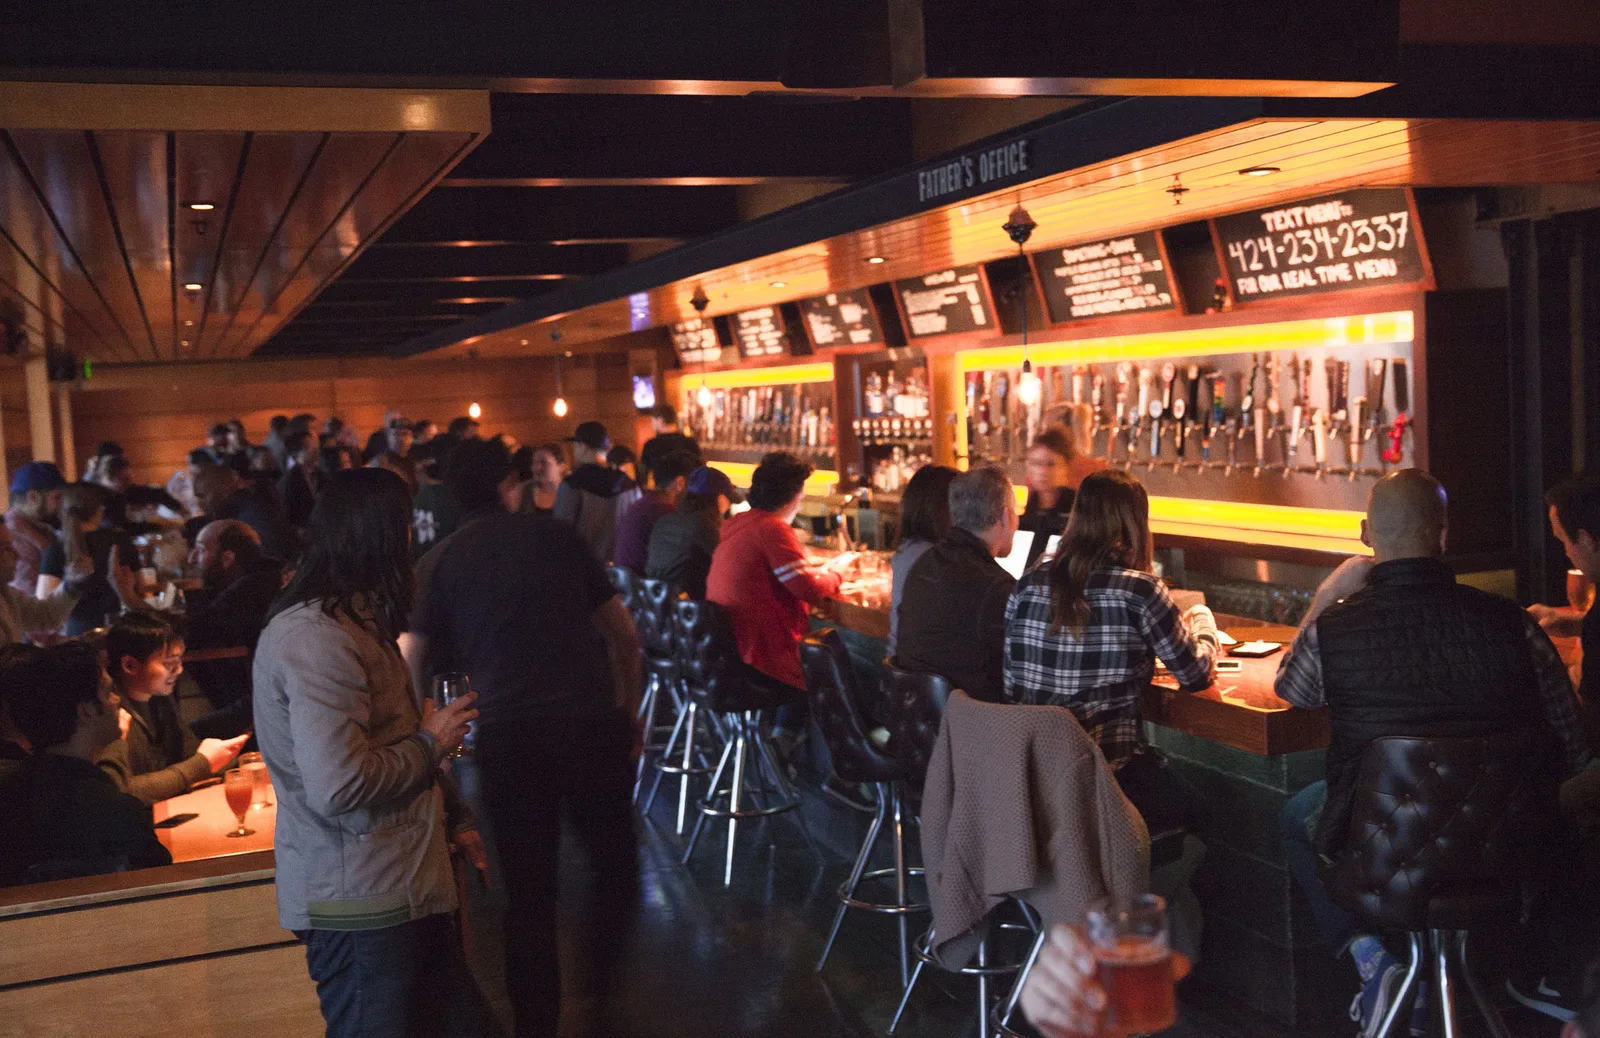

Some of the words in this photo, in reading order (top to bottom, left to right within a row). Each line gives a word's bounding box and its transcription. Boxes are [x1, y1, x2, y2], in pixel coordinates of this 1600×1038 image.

[919, 155, 973, 202] FATHER'S
[980, 139, 1028, 183] OFFICE
[1261, 206, 1304, 233] TEXT
[1304, 200, 1342, 226] MENU
[1228, 210, 1409, 273] 424-234-2337
[1281, 268, 1318, 289] REAL
[1314, 262, 1353, 284] TIME
[1353, 258, 1398, 281] MENU
